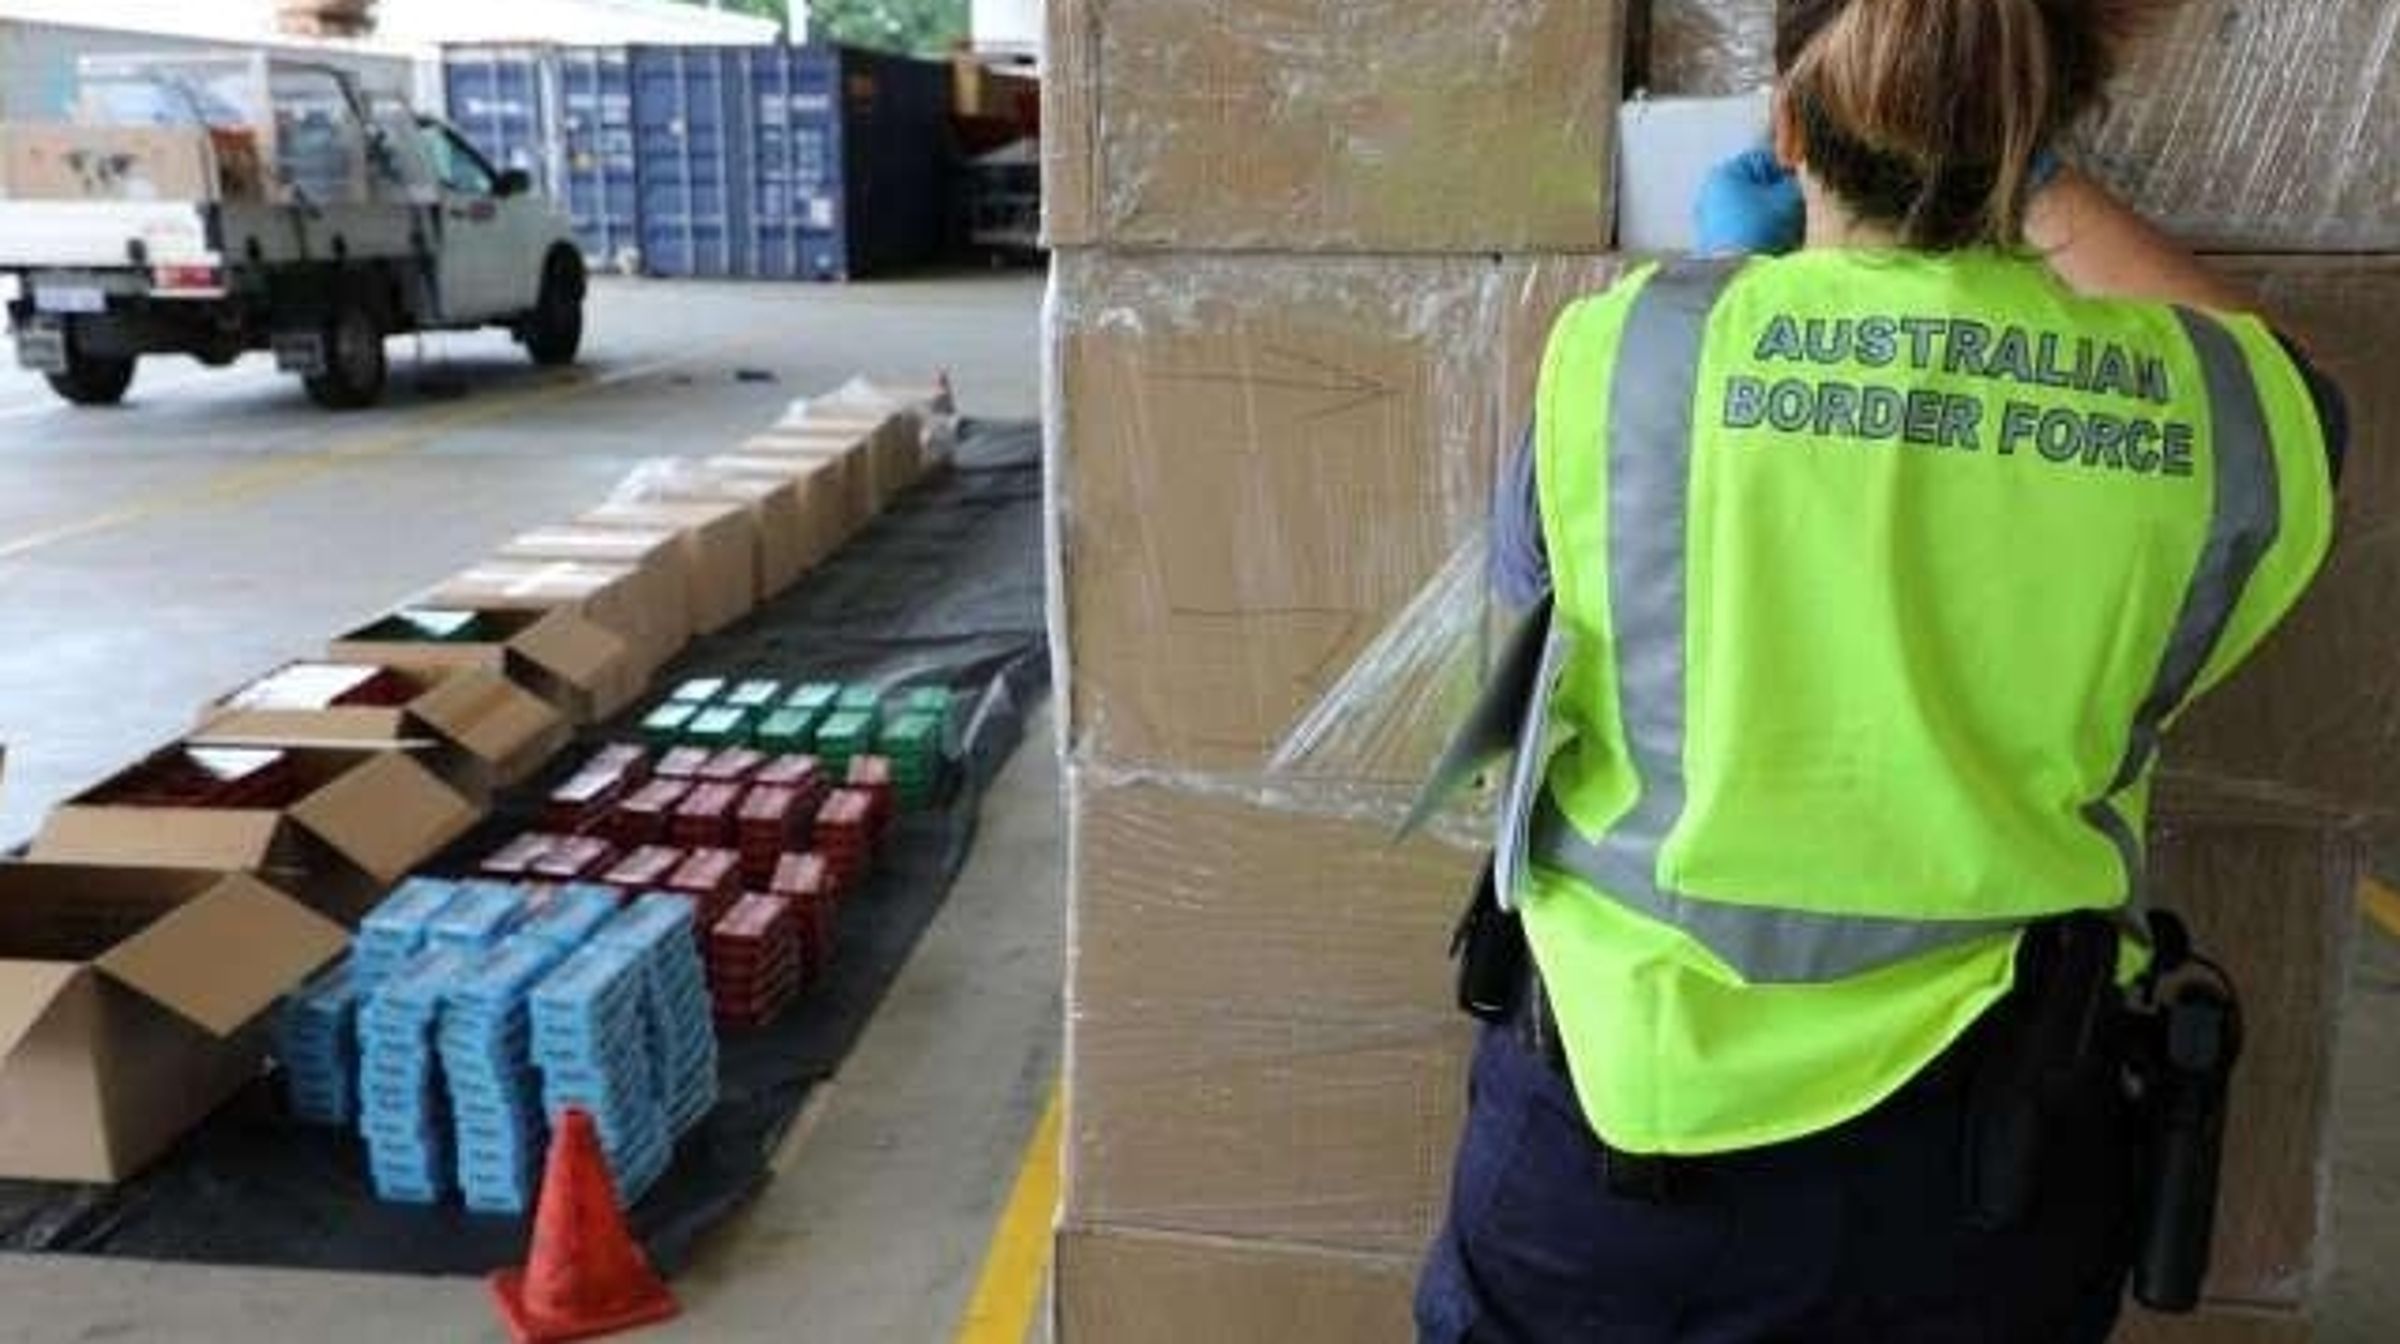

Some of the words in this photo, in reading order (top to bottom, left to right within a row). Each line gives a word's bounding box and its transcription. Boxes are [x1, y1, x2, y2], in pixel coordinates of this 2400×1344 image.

[1754, 315, 2168, 405] AUSTRALIAN
[1723, 376, 1982, 449] BORDER
[1997, 402, 2194, 476] FORCE
